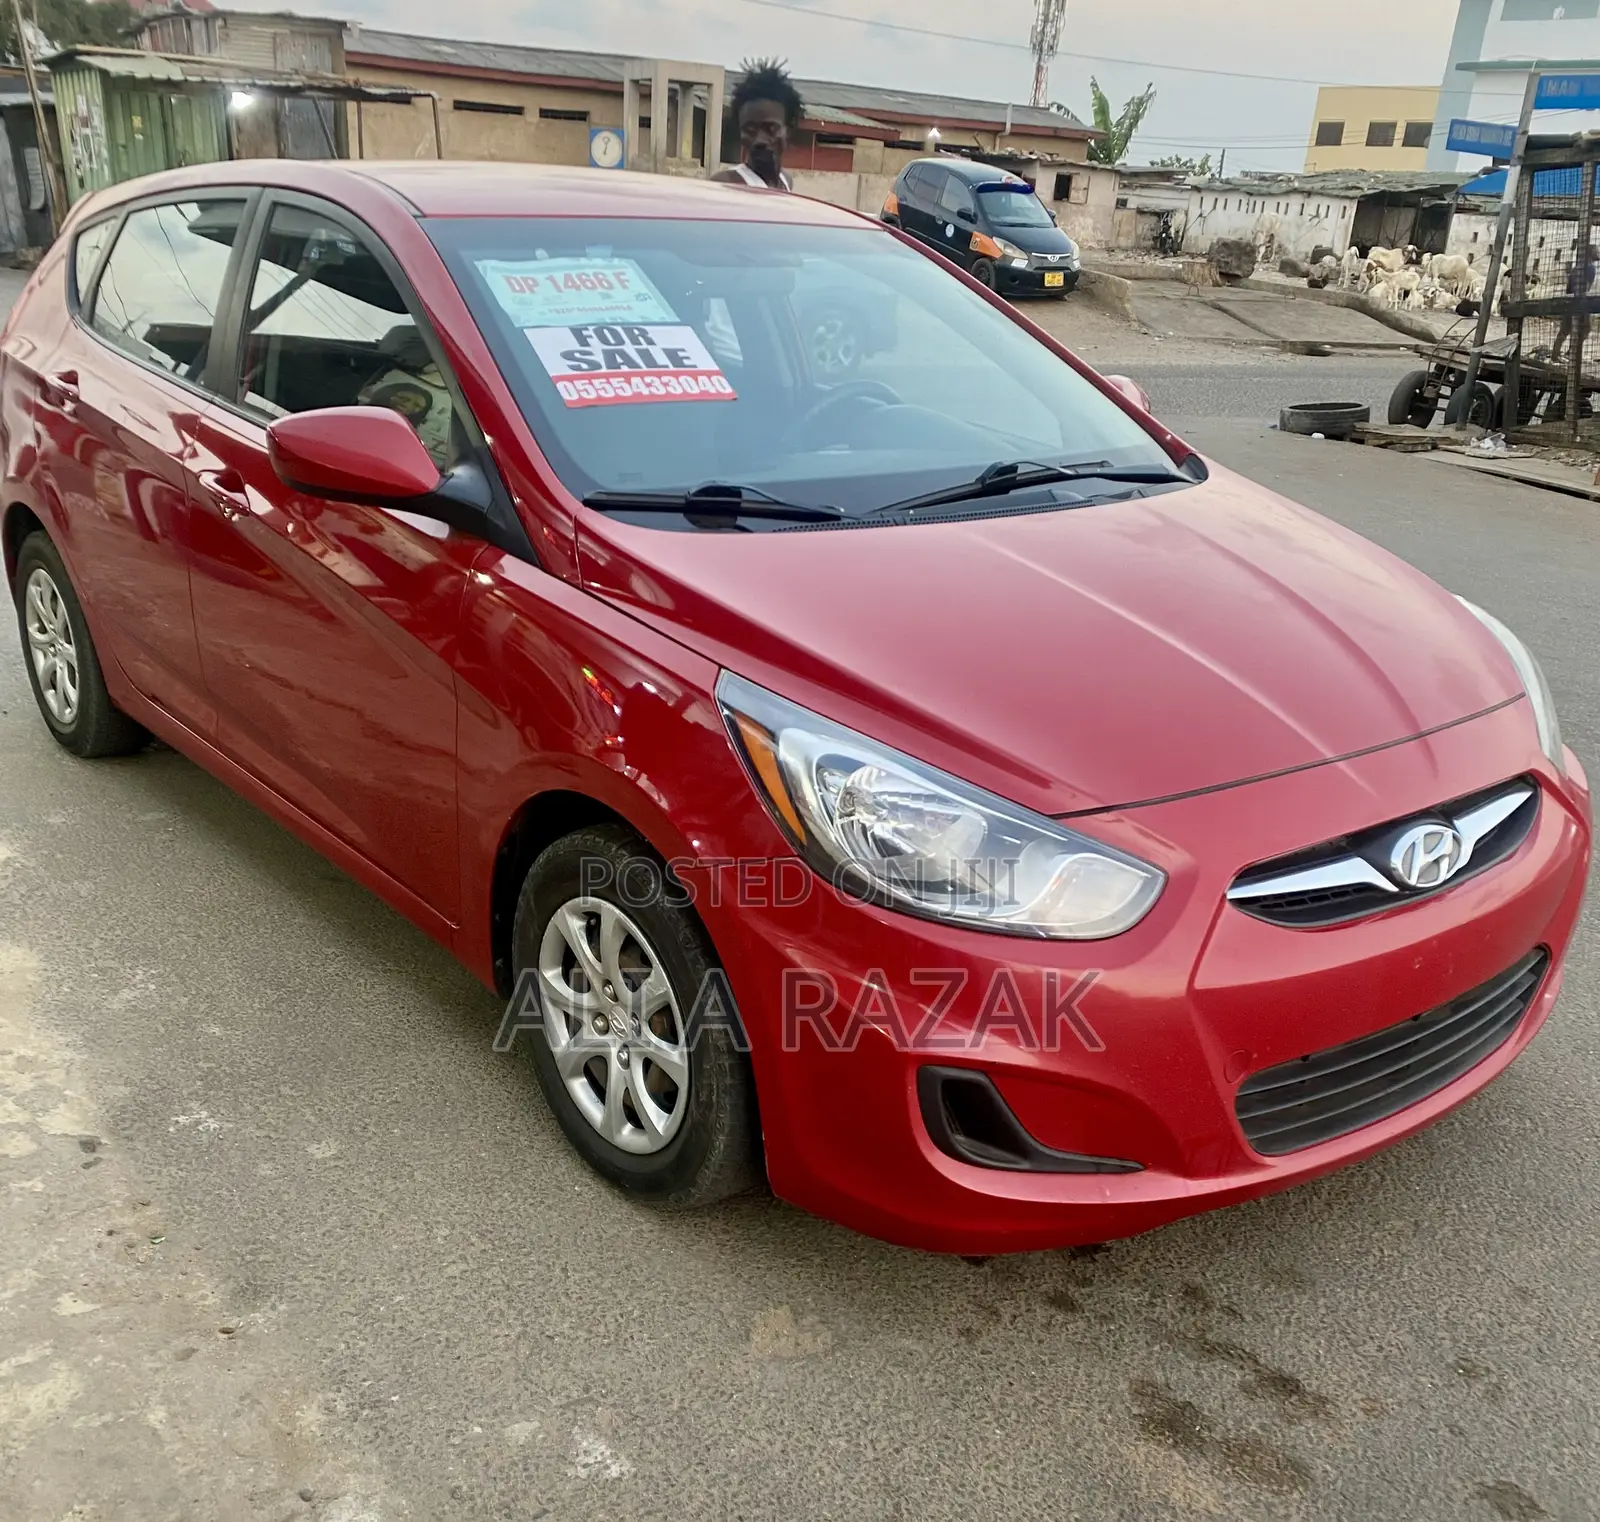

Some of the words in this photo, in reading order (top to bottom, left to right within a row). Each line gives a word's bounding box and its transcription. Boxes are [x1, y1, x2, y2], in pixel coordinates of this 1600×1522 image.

[502, 274, 539, 294] DP
[545, 271, 614, 293] 1466
[613, 271, 630, 289] F
[568, 325, 656, 348] FOR
[559, 348, 698, 372] SALE
[555, 375, 733, 401] 0555433040
